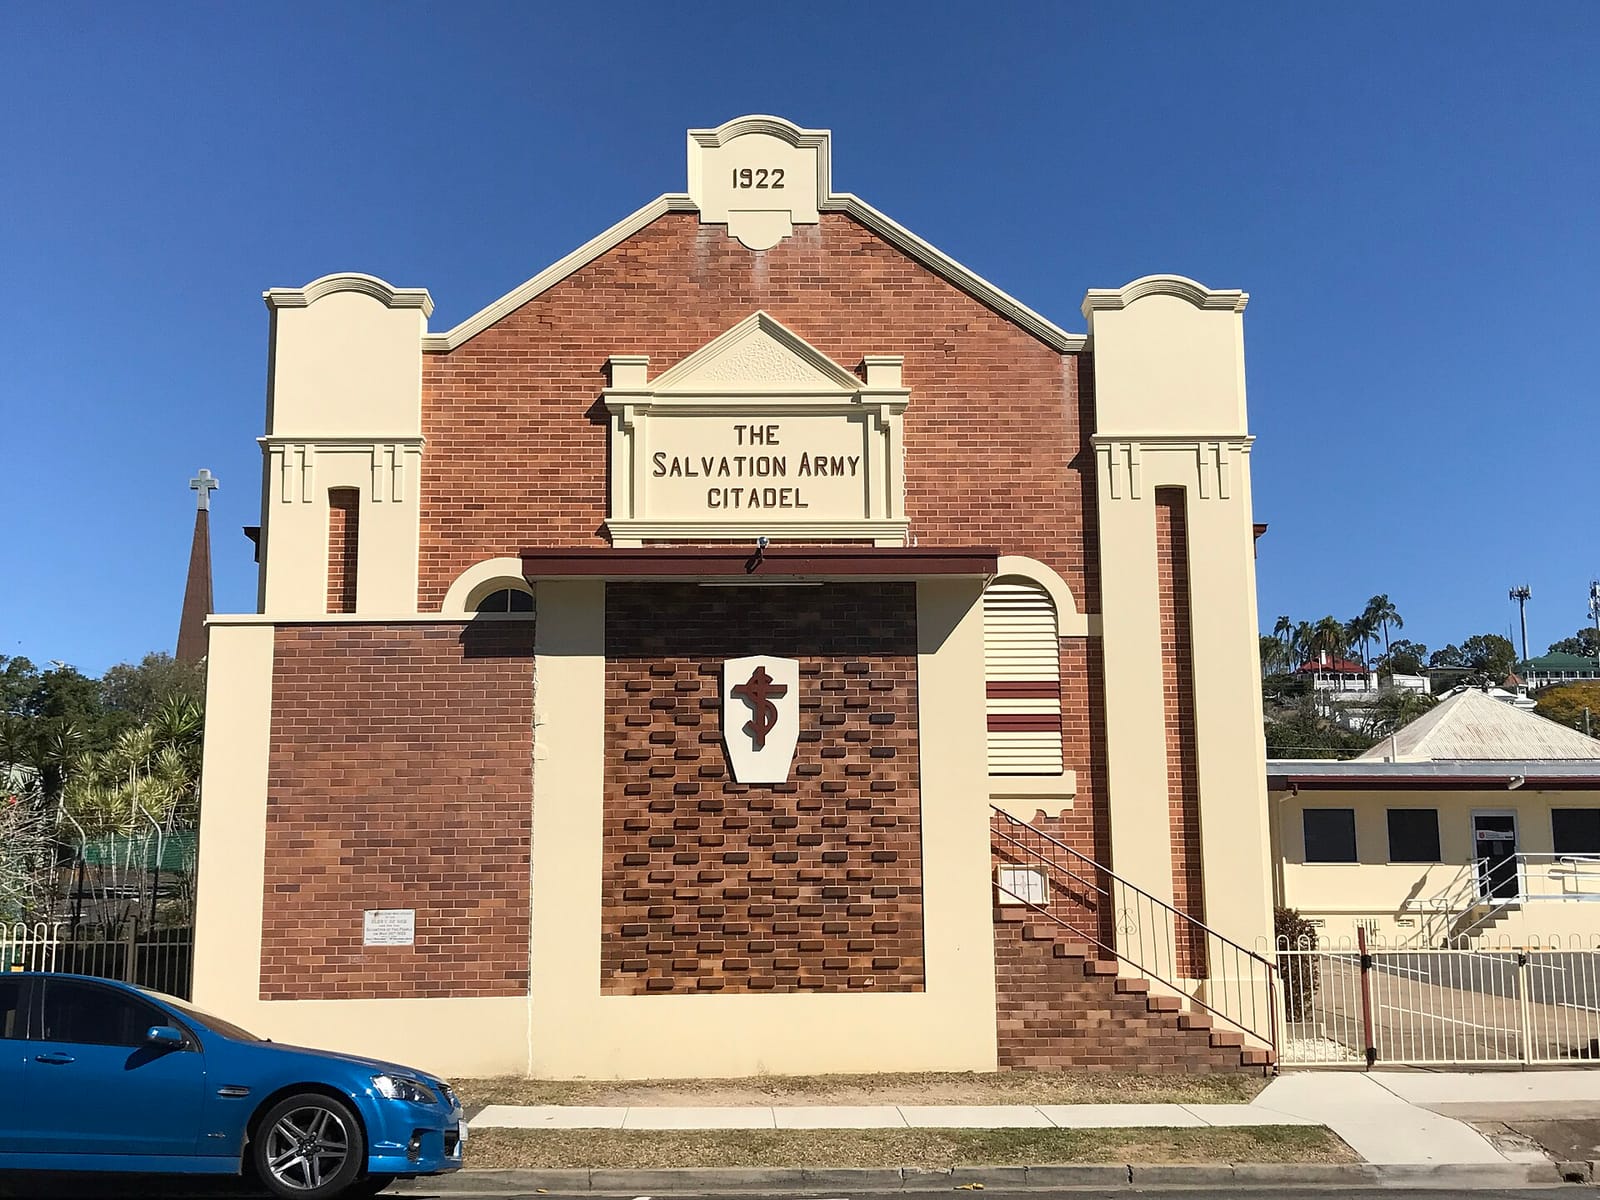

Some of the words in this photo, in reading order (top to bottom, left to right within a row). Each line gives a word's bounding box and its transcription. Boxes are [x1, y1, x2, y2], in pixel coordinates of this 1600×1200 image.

[733, 168, 785, 189] 1922
[734, 425, 780, 446] THE
[652, 452, 787, 478] SALVATION
[797, 452, 861, 477] ARMY
[707, 488, 809, 509] CITADEL
